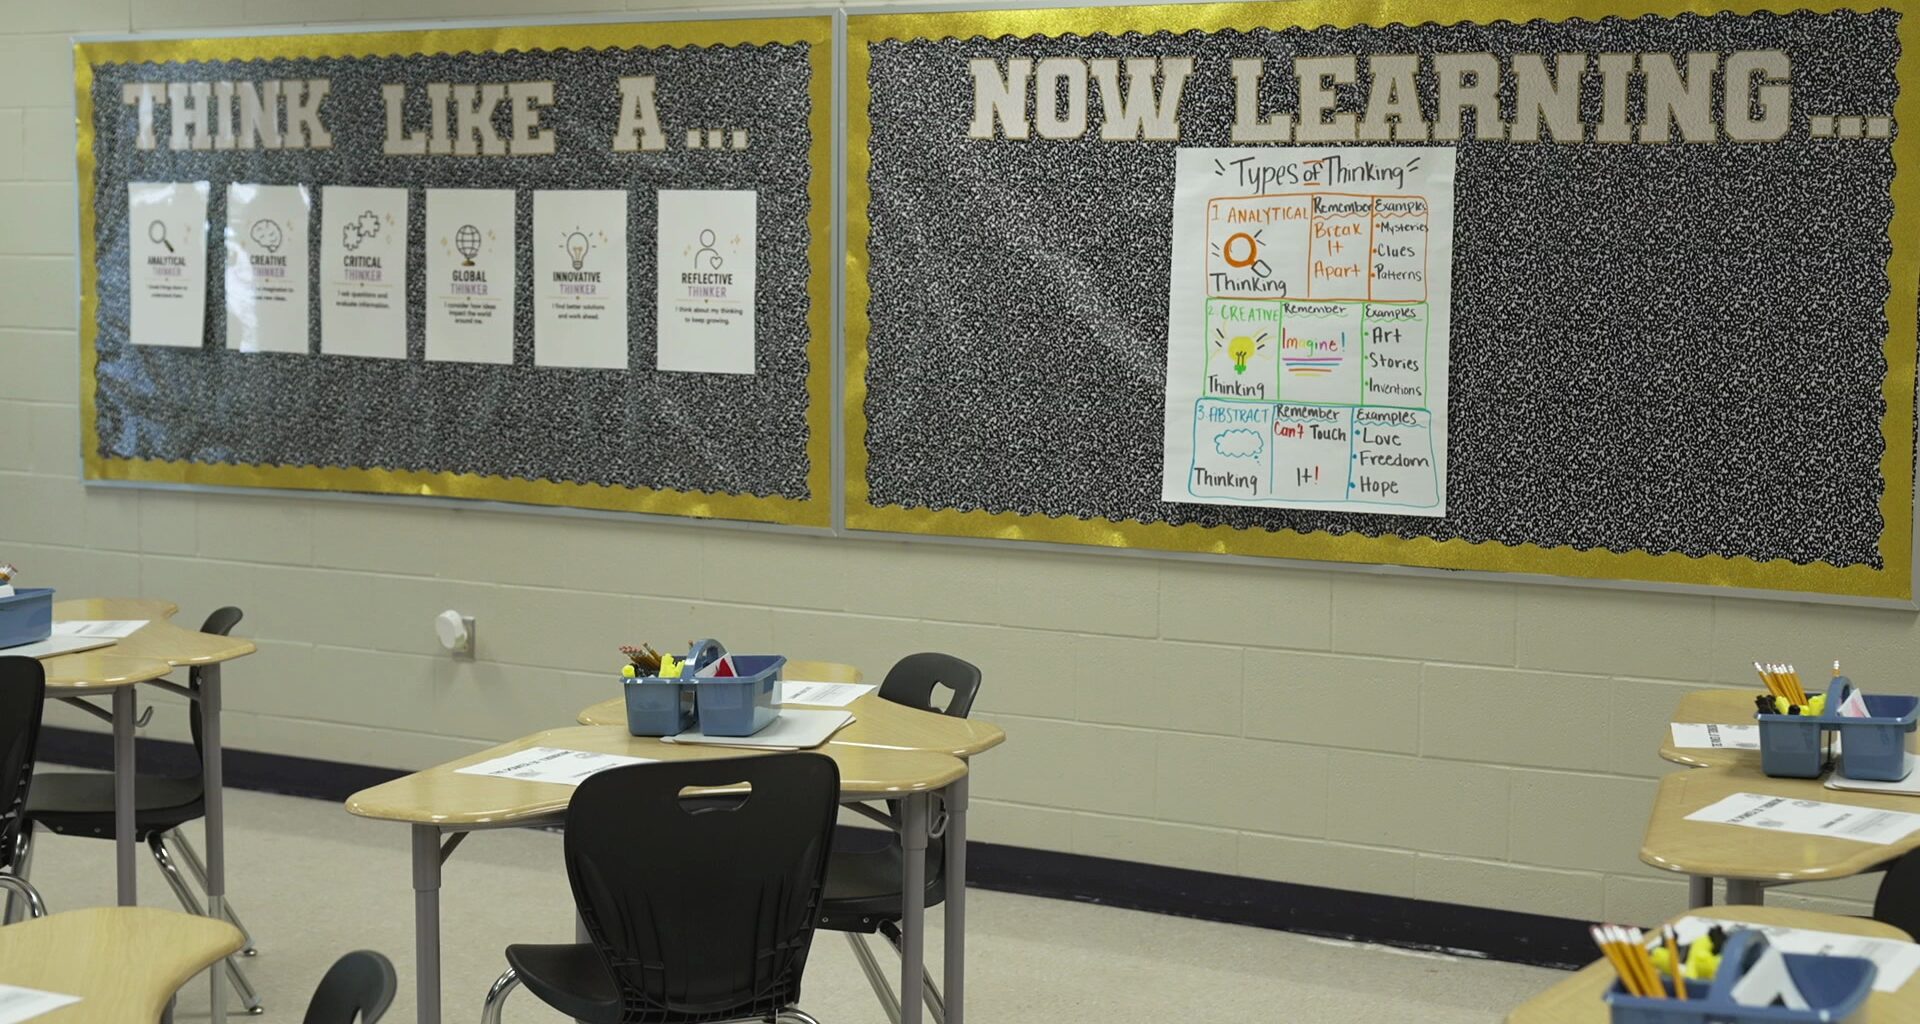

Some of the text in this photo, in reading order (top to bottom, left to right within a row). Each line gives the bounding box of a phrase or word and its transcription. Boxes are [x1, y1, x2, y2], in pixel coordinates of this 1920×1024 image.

[968, 56, 1194, 142] NOW
[122, 79, 333, 150] THINK
[382, 80, 556, 156] LIKE
[1230, 155, 1404, 195] Types of Thinking
[1227, 206, 1309, 225] ANALYTICAL
[1314, 221, 1362, 239] Break
[1377, 242, 1416, 258] Clues
[250, 254, 287, 267] CREATIVE
[343, 255, 383, 269] CRITICAL
[452, 269, 488, 282] GLOBAL
[553, 271, 602, 283] INNOVATIVE
[681, 272, 734, 286] REFLECTIVE
[1314, 260, 1361, 281] Apart
[1374, 262, 1423, 282] Patterns
[451, 282, 489, 296] THINKER
[560, 283, 597, 296] THINKER
[688, 285, 728, 298] THINKER
[1209, 272, 1287, 298] Thinking
[1221, 304, 1280, 322] CREATIVE
[1283, 303, 1348, 314] Remember
[1365, 304, 1417, 320] Examples
[1372, 326, 1402, 345] Art
[1369, 352, 1420, 373] Stories
[1208, 374, 1265, 401] Thinking
[1369, 377, 1423, 397] Inventions
[1209, 407, 1270, 424] ABSTRACT
[1276, 404, 1340, 421] Remember
[1356, 408, 1417, 425] Examples
[1309, 424, 1347, 442] Touch
[1363, 427, 1402, 447] Love
[1360, 450, 1430, 468] Freedom
[1194, 467, 1258, 497] Thinking
[1360, 475, 1399, 498] Hope
